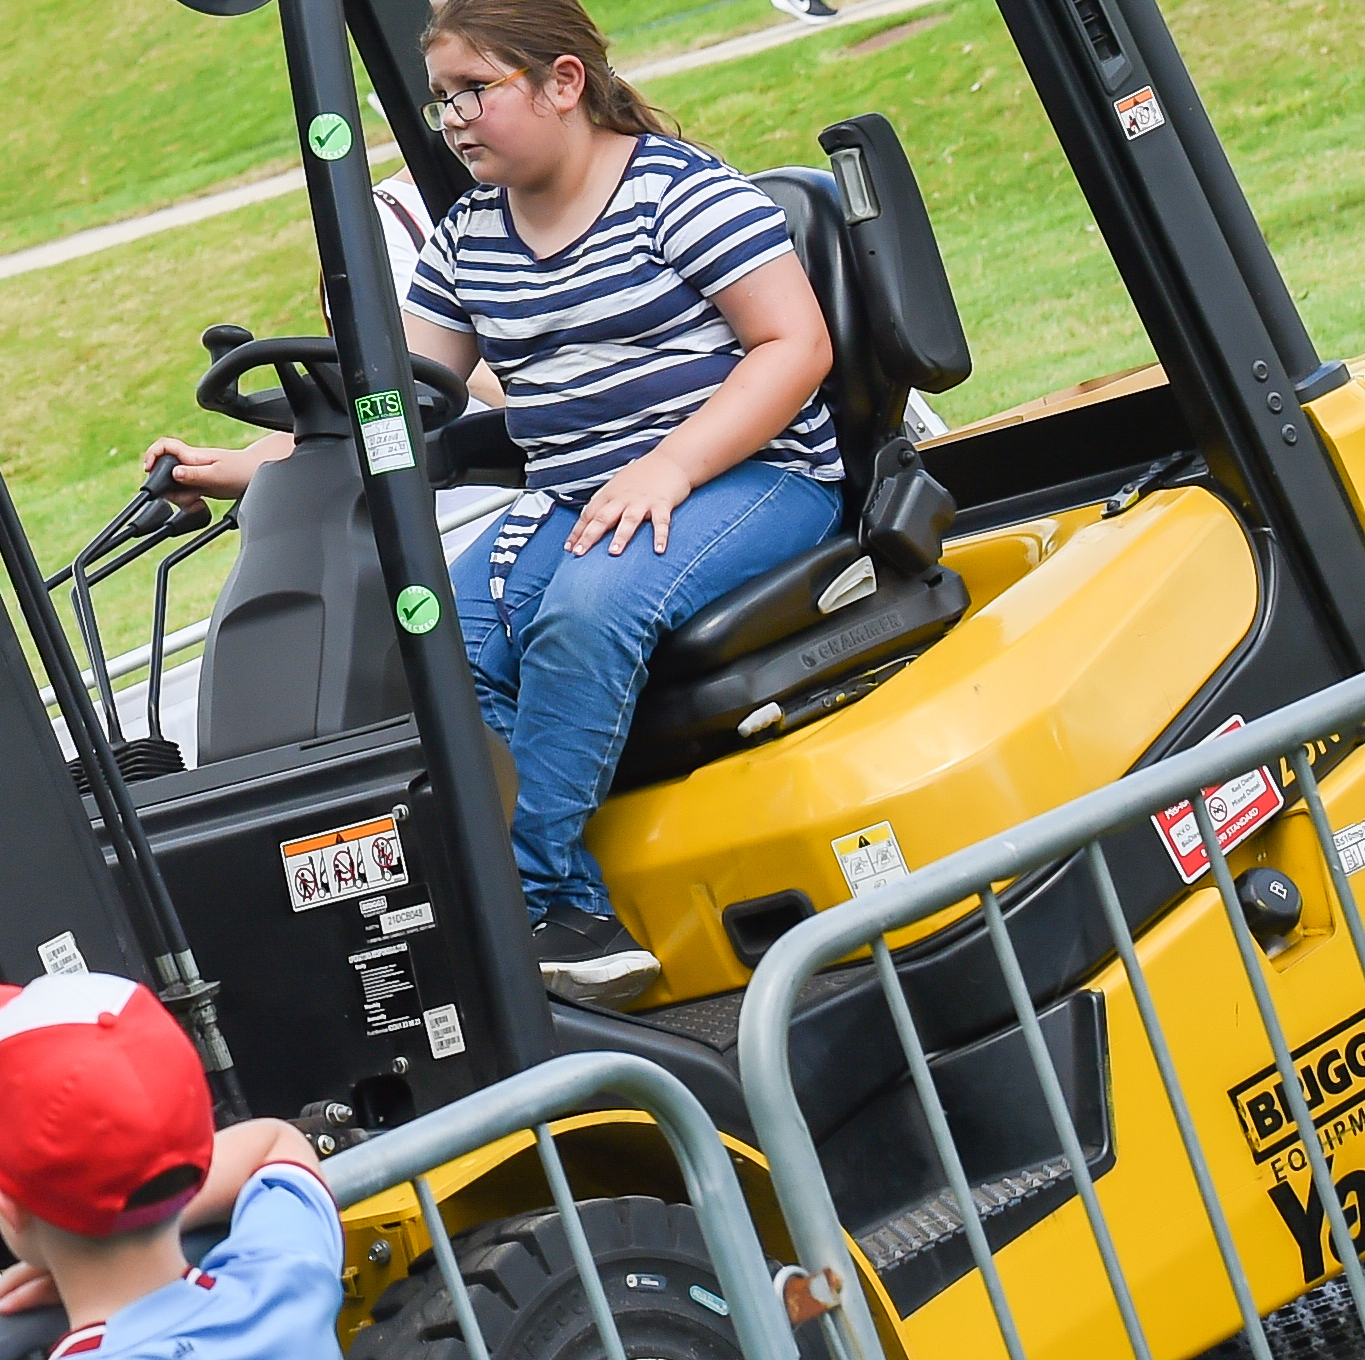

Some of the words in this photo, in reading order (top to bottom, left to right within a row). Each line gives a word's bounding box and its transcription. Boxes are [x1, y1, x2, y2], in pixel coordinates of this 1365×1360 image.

[358, 394, 400, 419] RTS
[819, 610, 903, 659] GRAMMER
[1226, 807, 1259, 837] STANDARD
